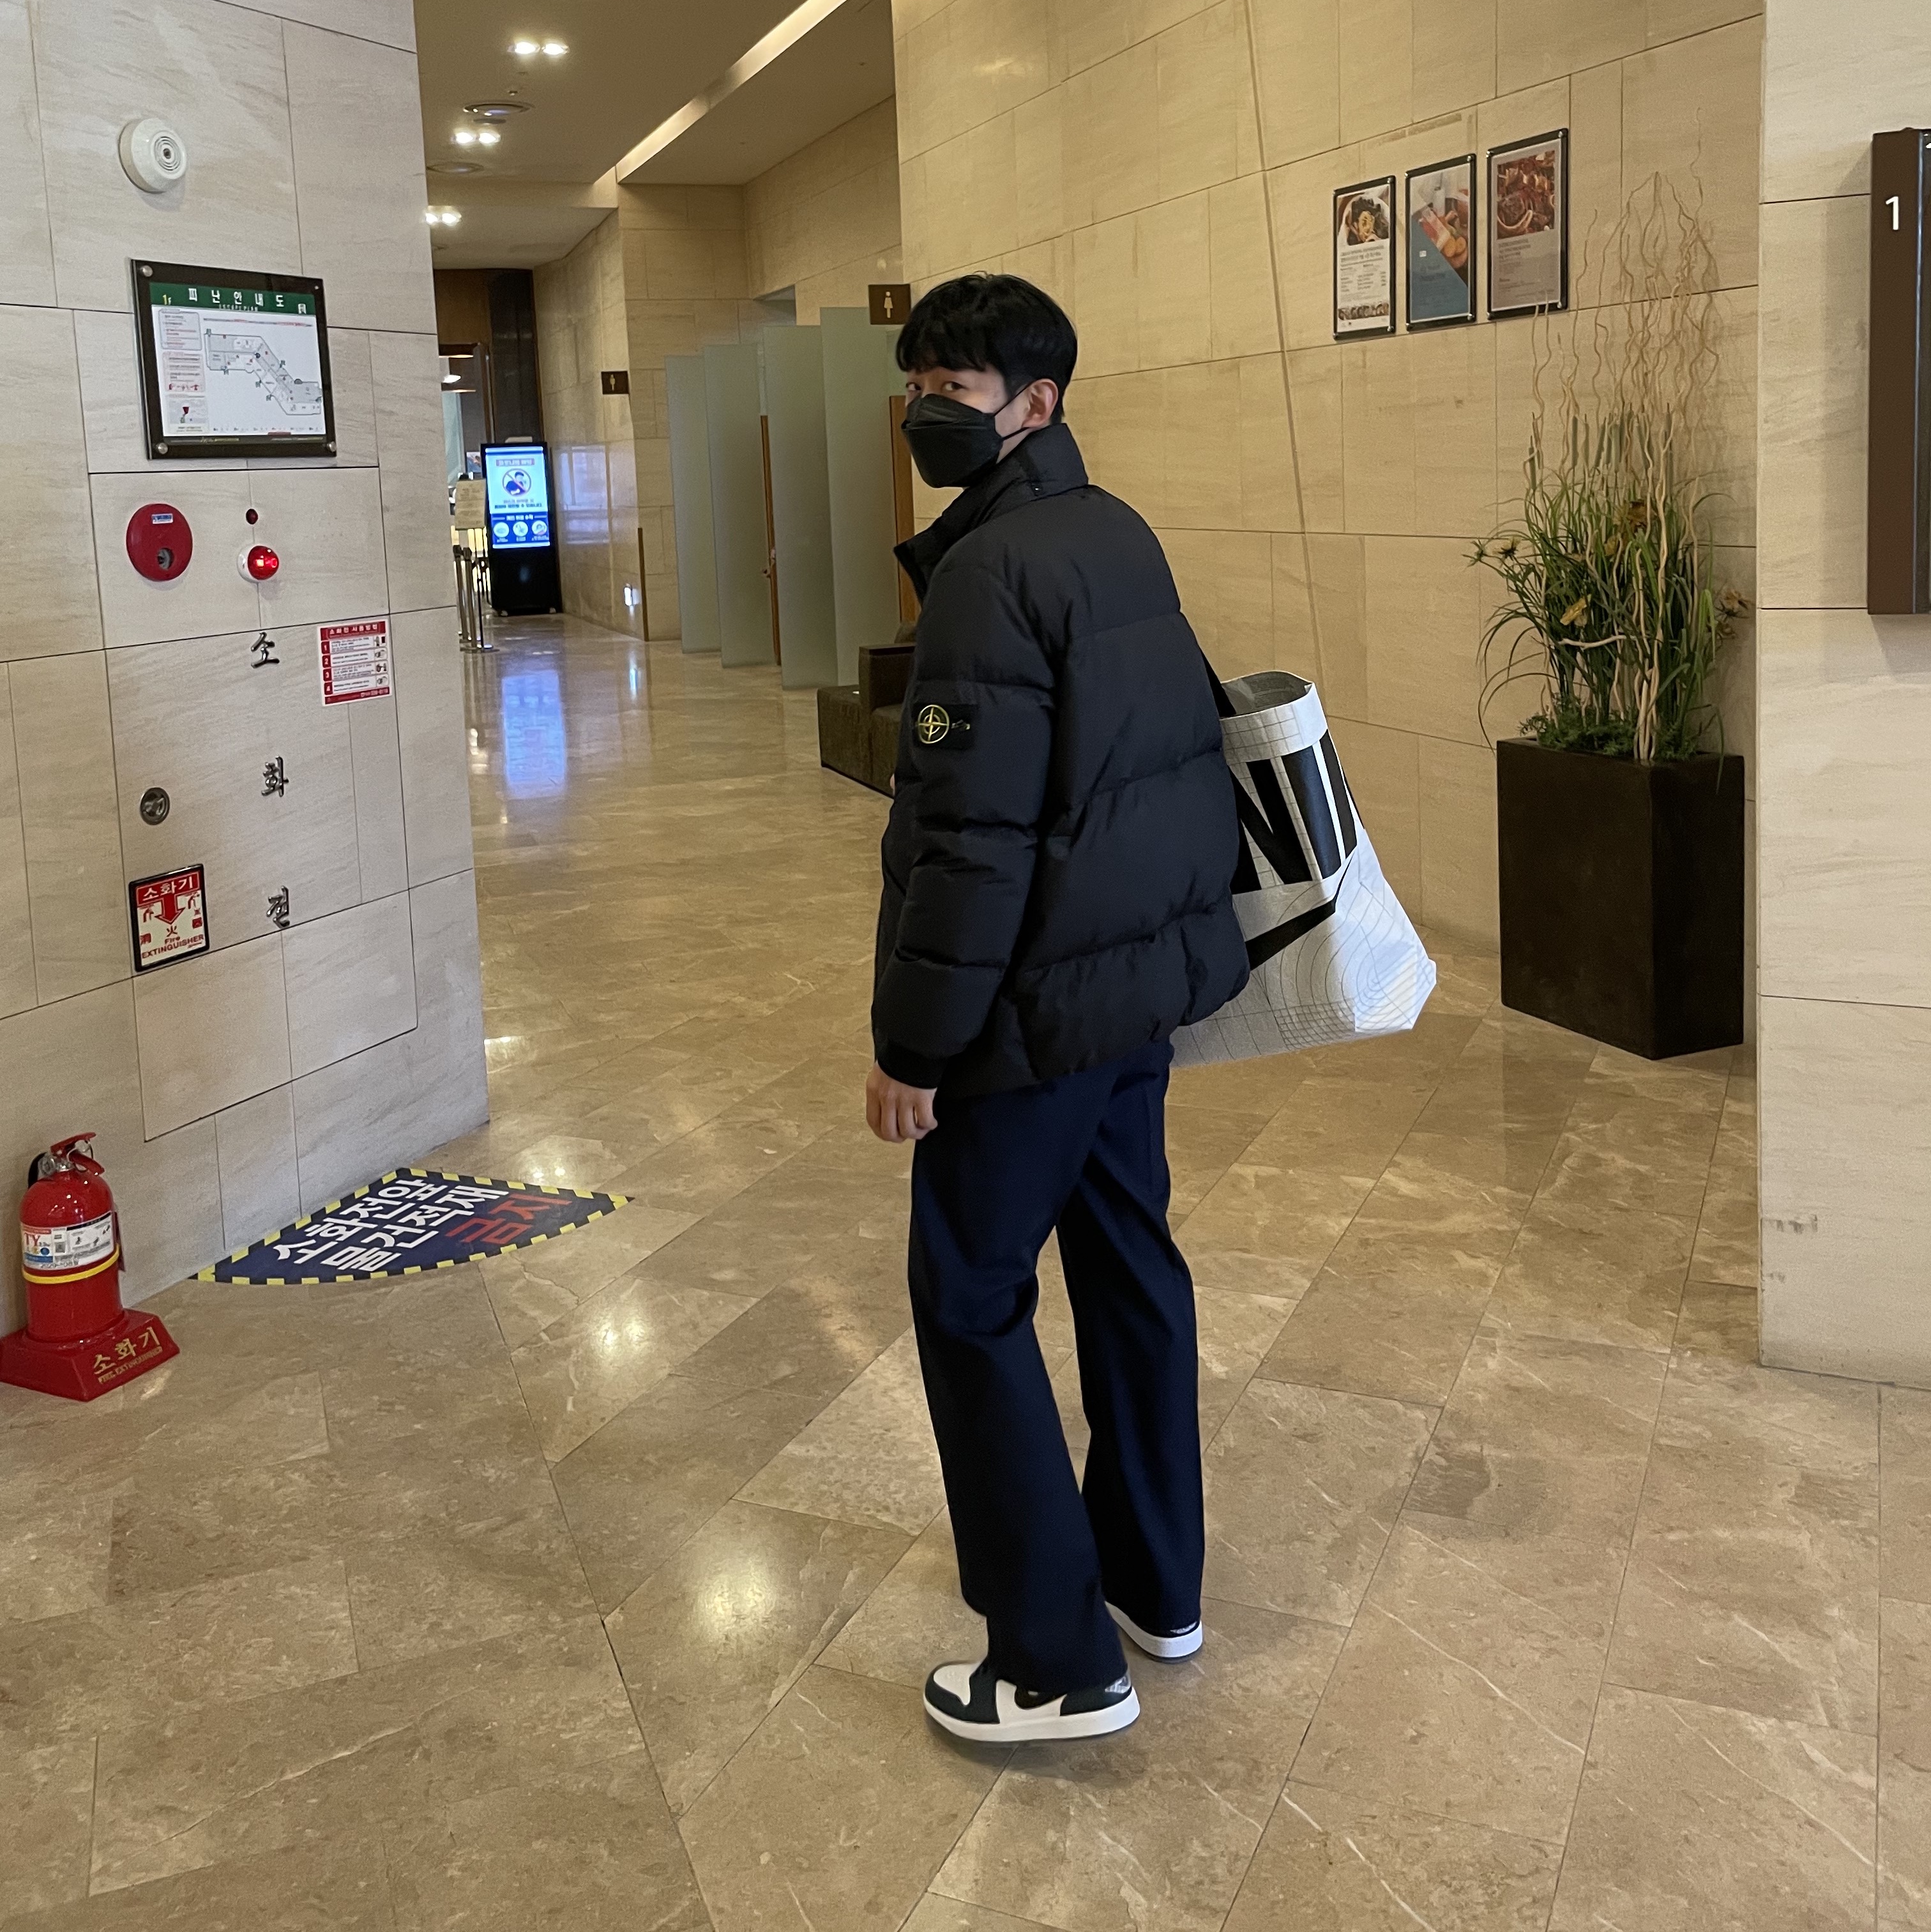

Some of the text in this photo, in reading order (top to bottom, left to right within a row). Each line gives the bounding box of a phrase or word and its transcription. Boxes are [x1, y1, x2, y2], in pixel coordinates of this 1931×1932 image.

[1886, 195, 1899, 231] 1
[142, 876, 193, 901] 소화기
[141, 934, 204, 959] EXTINGUISHER
[445, 1193, 573, 1244] 금지
[94, 1327, 160, 1374] 소화기
